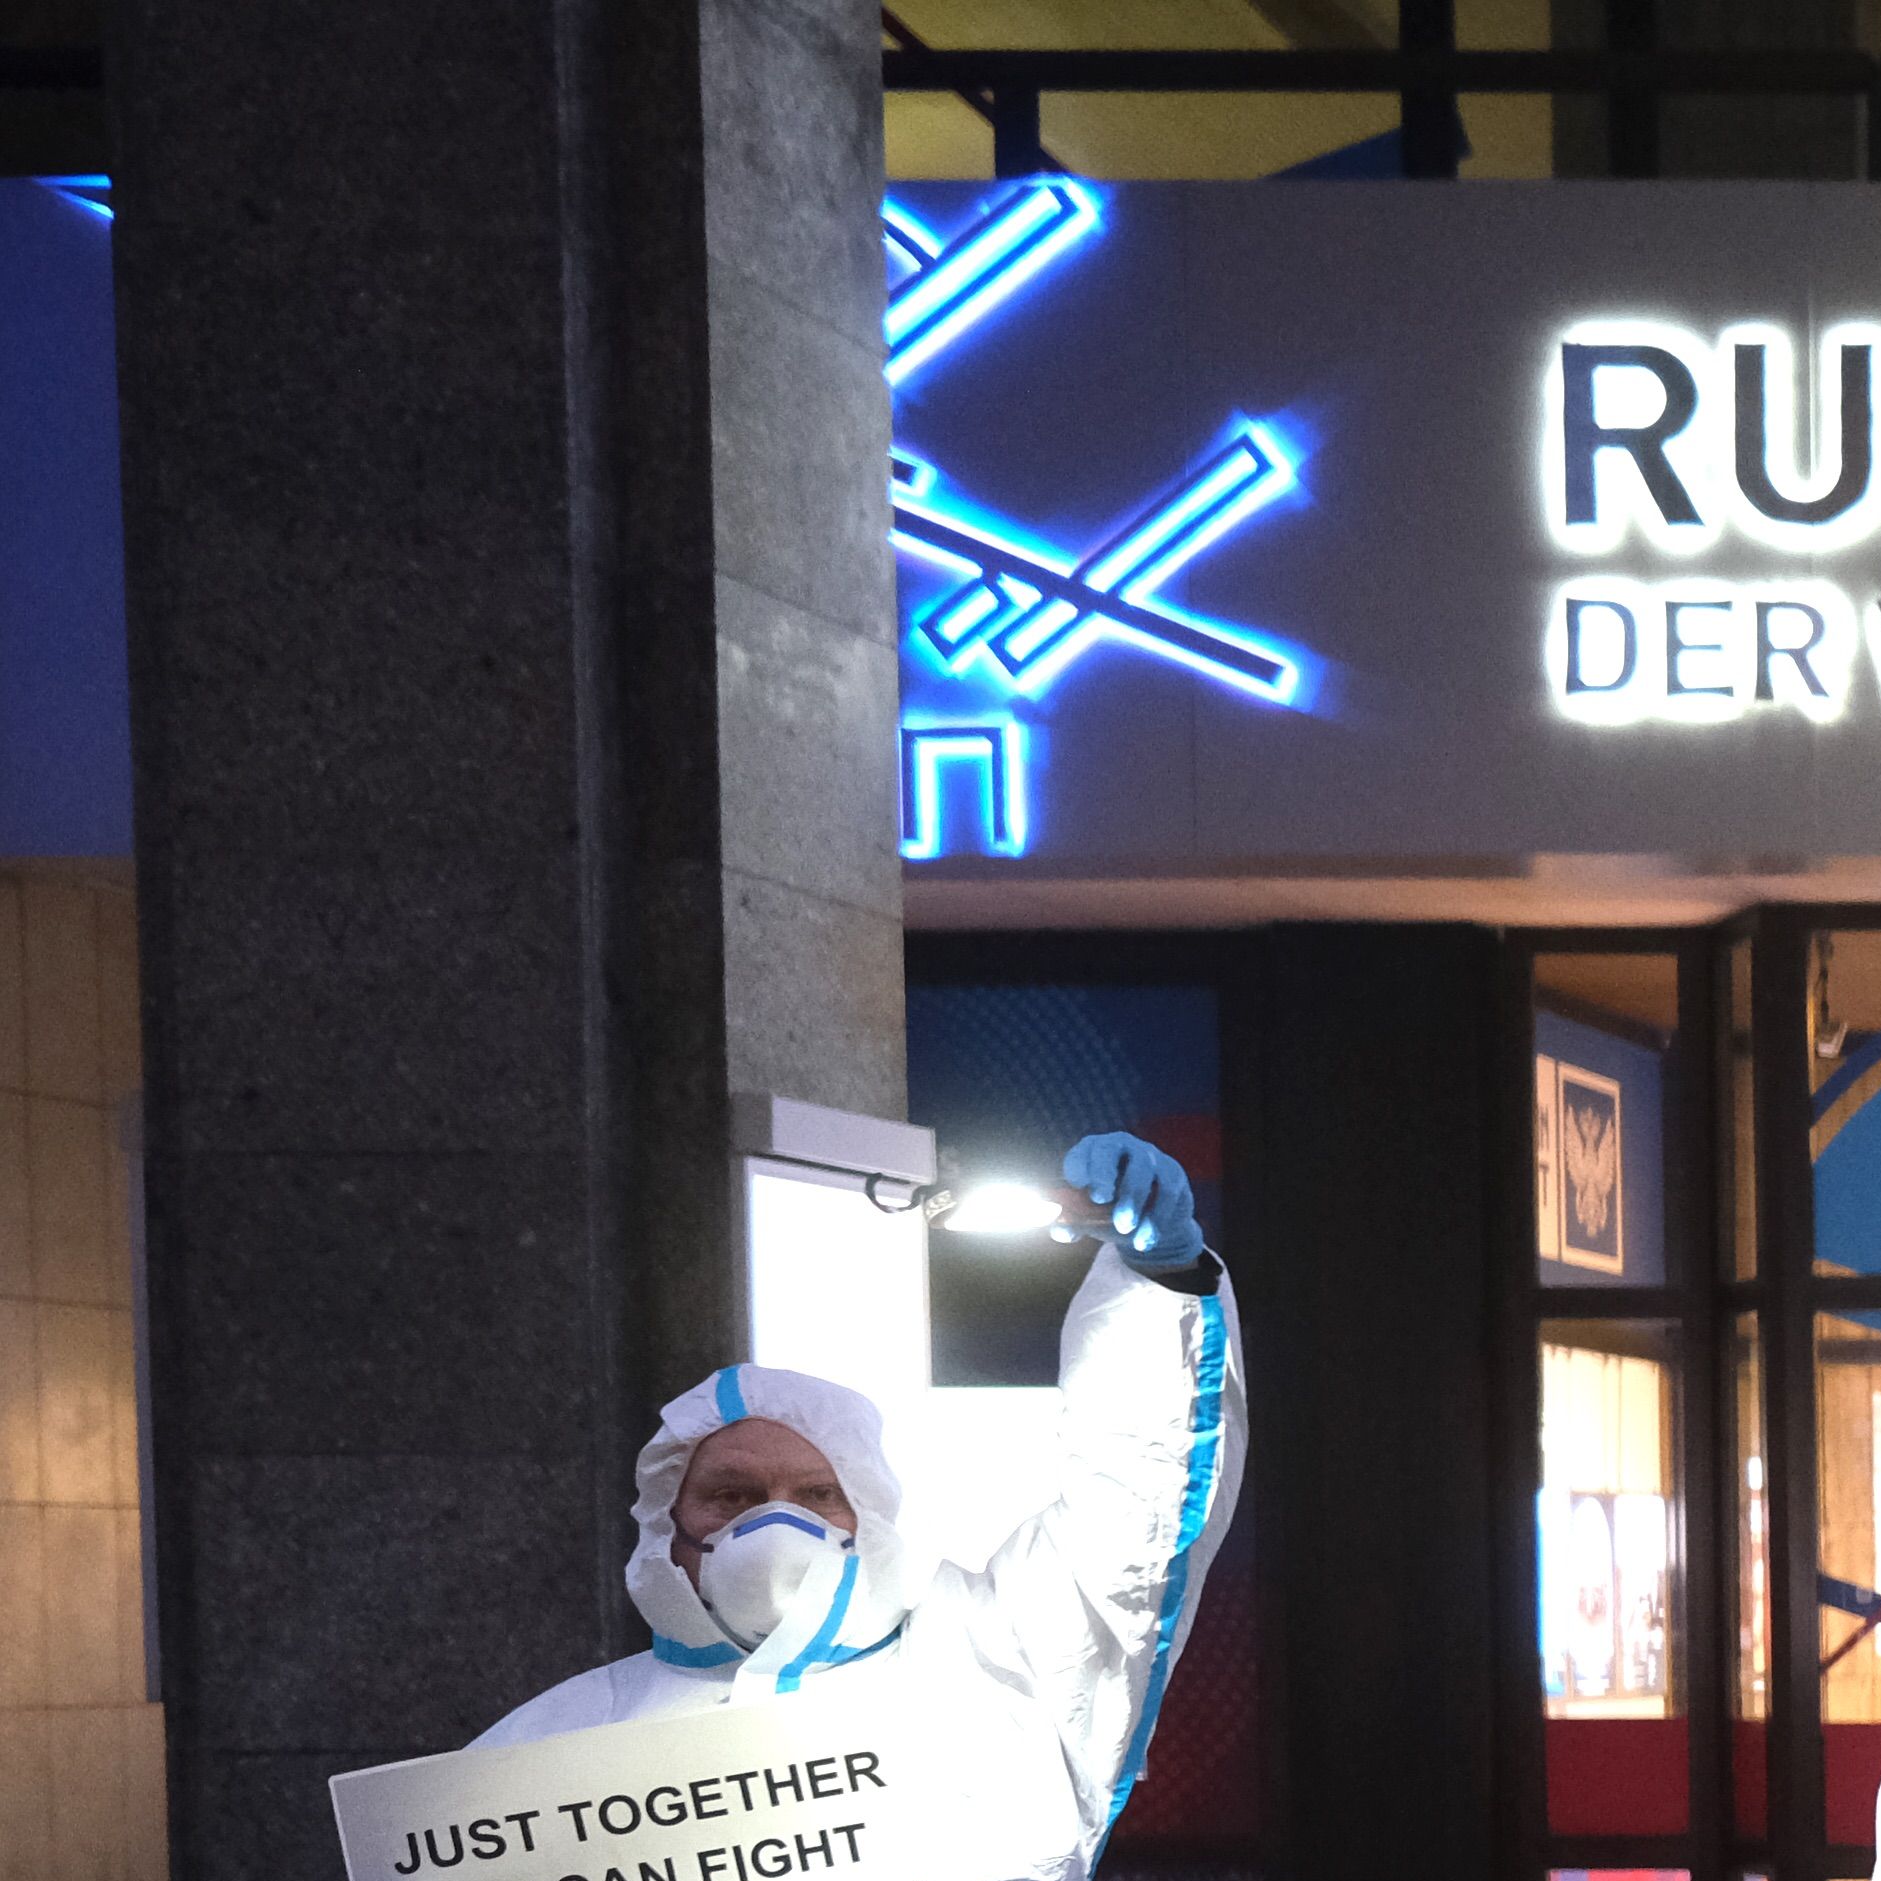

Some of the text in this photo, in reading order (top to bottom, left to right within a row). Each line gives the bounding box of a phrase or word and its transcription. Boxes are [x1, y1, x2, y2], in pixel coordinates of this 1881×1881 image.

[1562, 597, 1832, 701] DER
[394, 1750, 888, 1876] JUST TOGETHER
